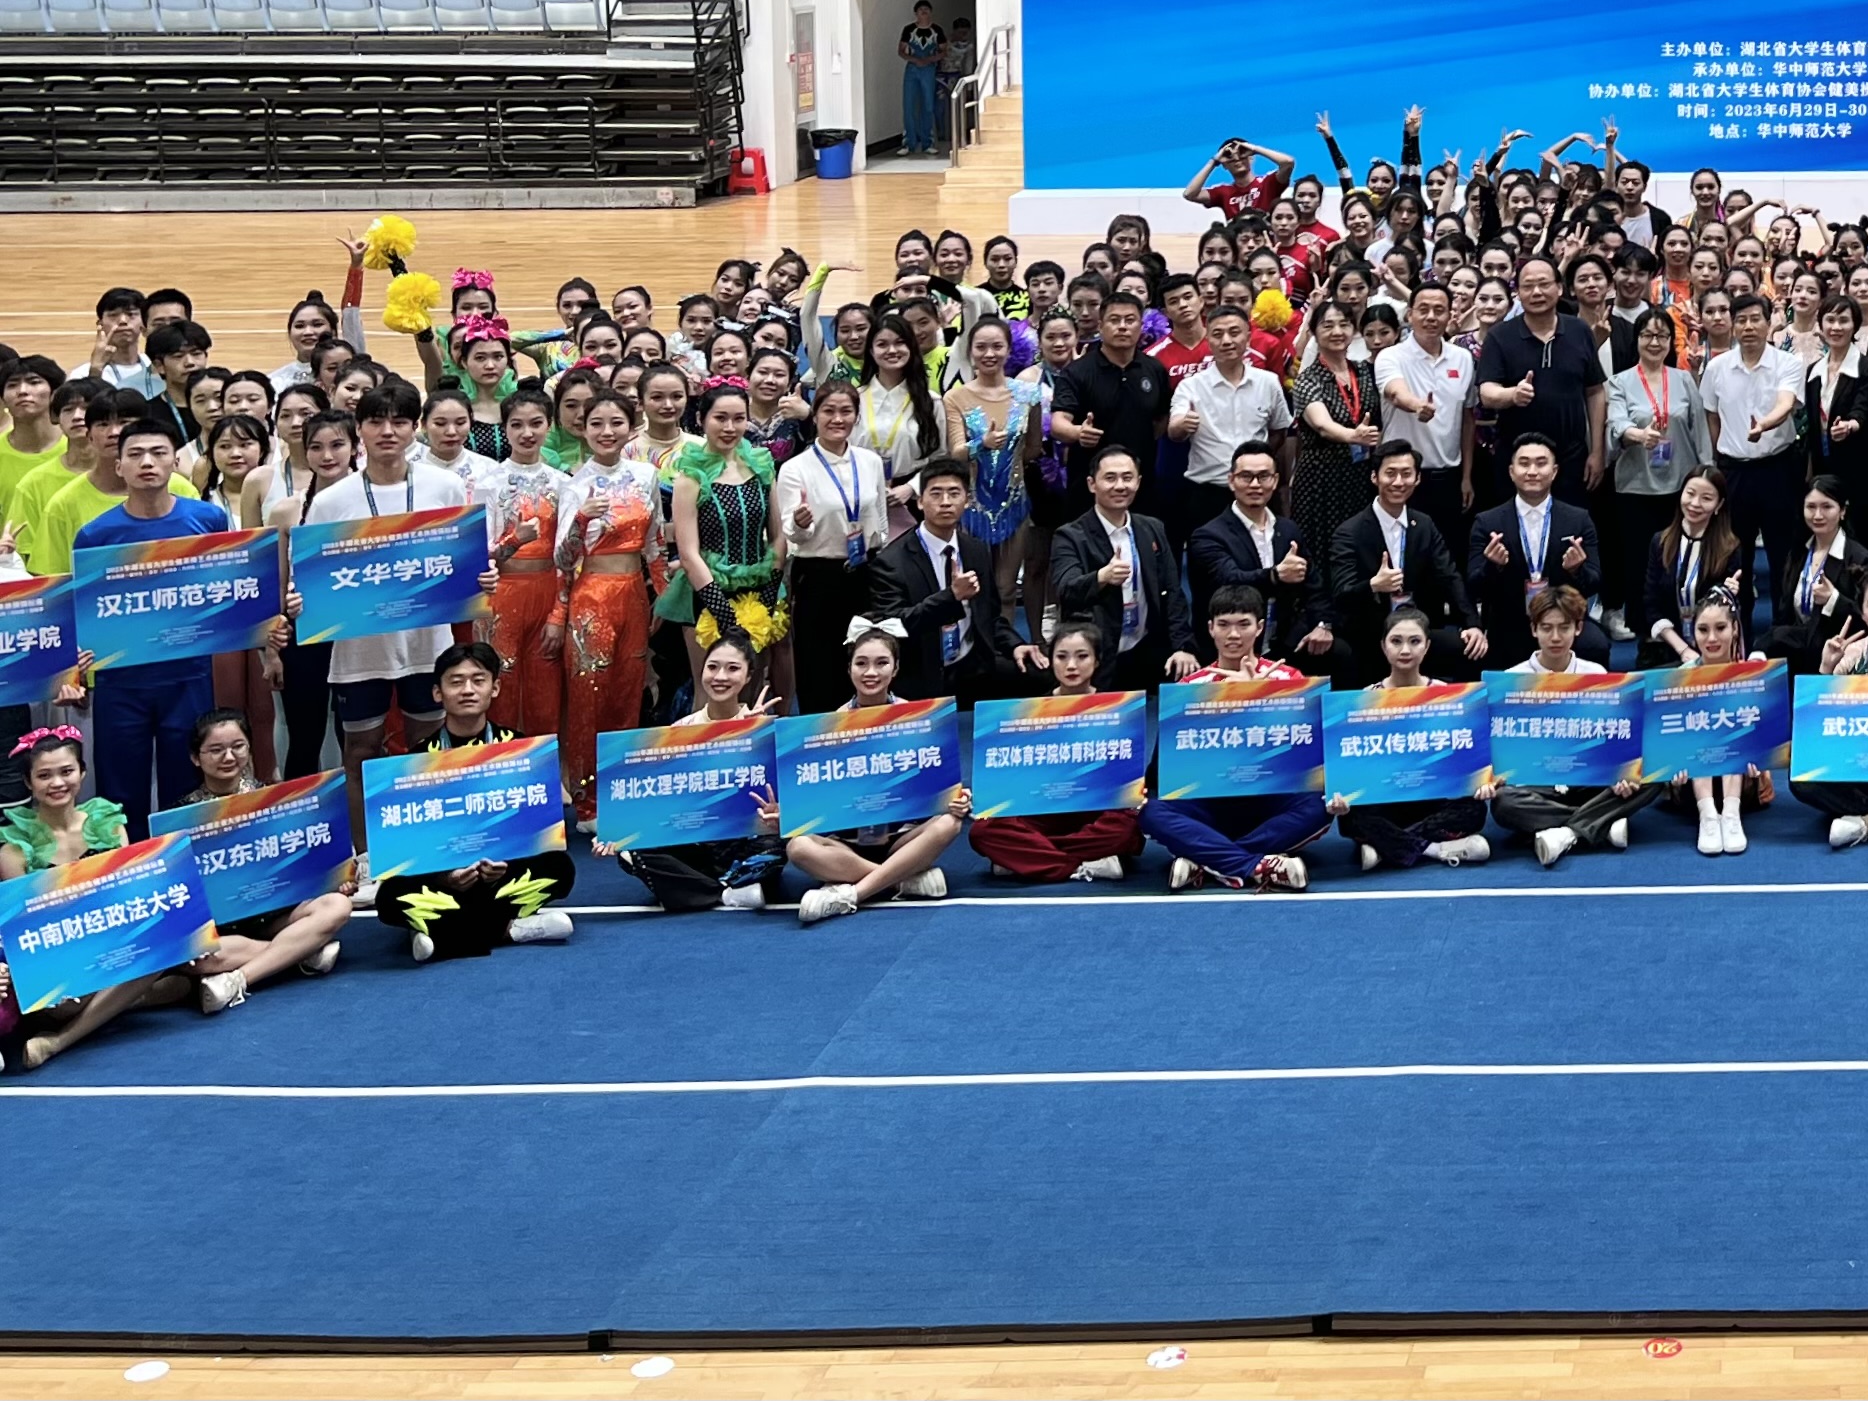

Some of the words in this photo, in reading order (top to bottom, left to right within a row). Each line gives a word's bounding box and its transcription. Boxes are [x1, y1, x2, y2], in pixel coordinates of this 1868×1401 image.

[1692, 61, 1868, 78] 承办单位：华中师范大学
[1708, 123, 1852, 140] 地点：华中师范大学
[330, 554, 454, 591] 文华学院
[96, 576, 260, 619] 汉江师范学院
[1174, 722, 1314, 751] 武汉体育学院
[1490, 715, 1632, 741] 湖北工程学院新技术学院
[1659, 704, 1761, 735] 三峡大学
[984, 738, 1133, 769] 武汉体育学院体育科技学院
[1339, 727, 1475, 758] 武汉传媒学院
[609, 763, 767, 802] 湖北文理学院理工学院
[795, 744, 943, 787] 湖北恩施学院
[380, 783, 548, 829] 湖北第二师范学院
[195, 821, 332, 877] 汉东湖学院
[18, 882, 191, 955] 中南财经政法大学
